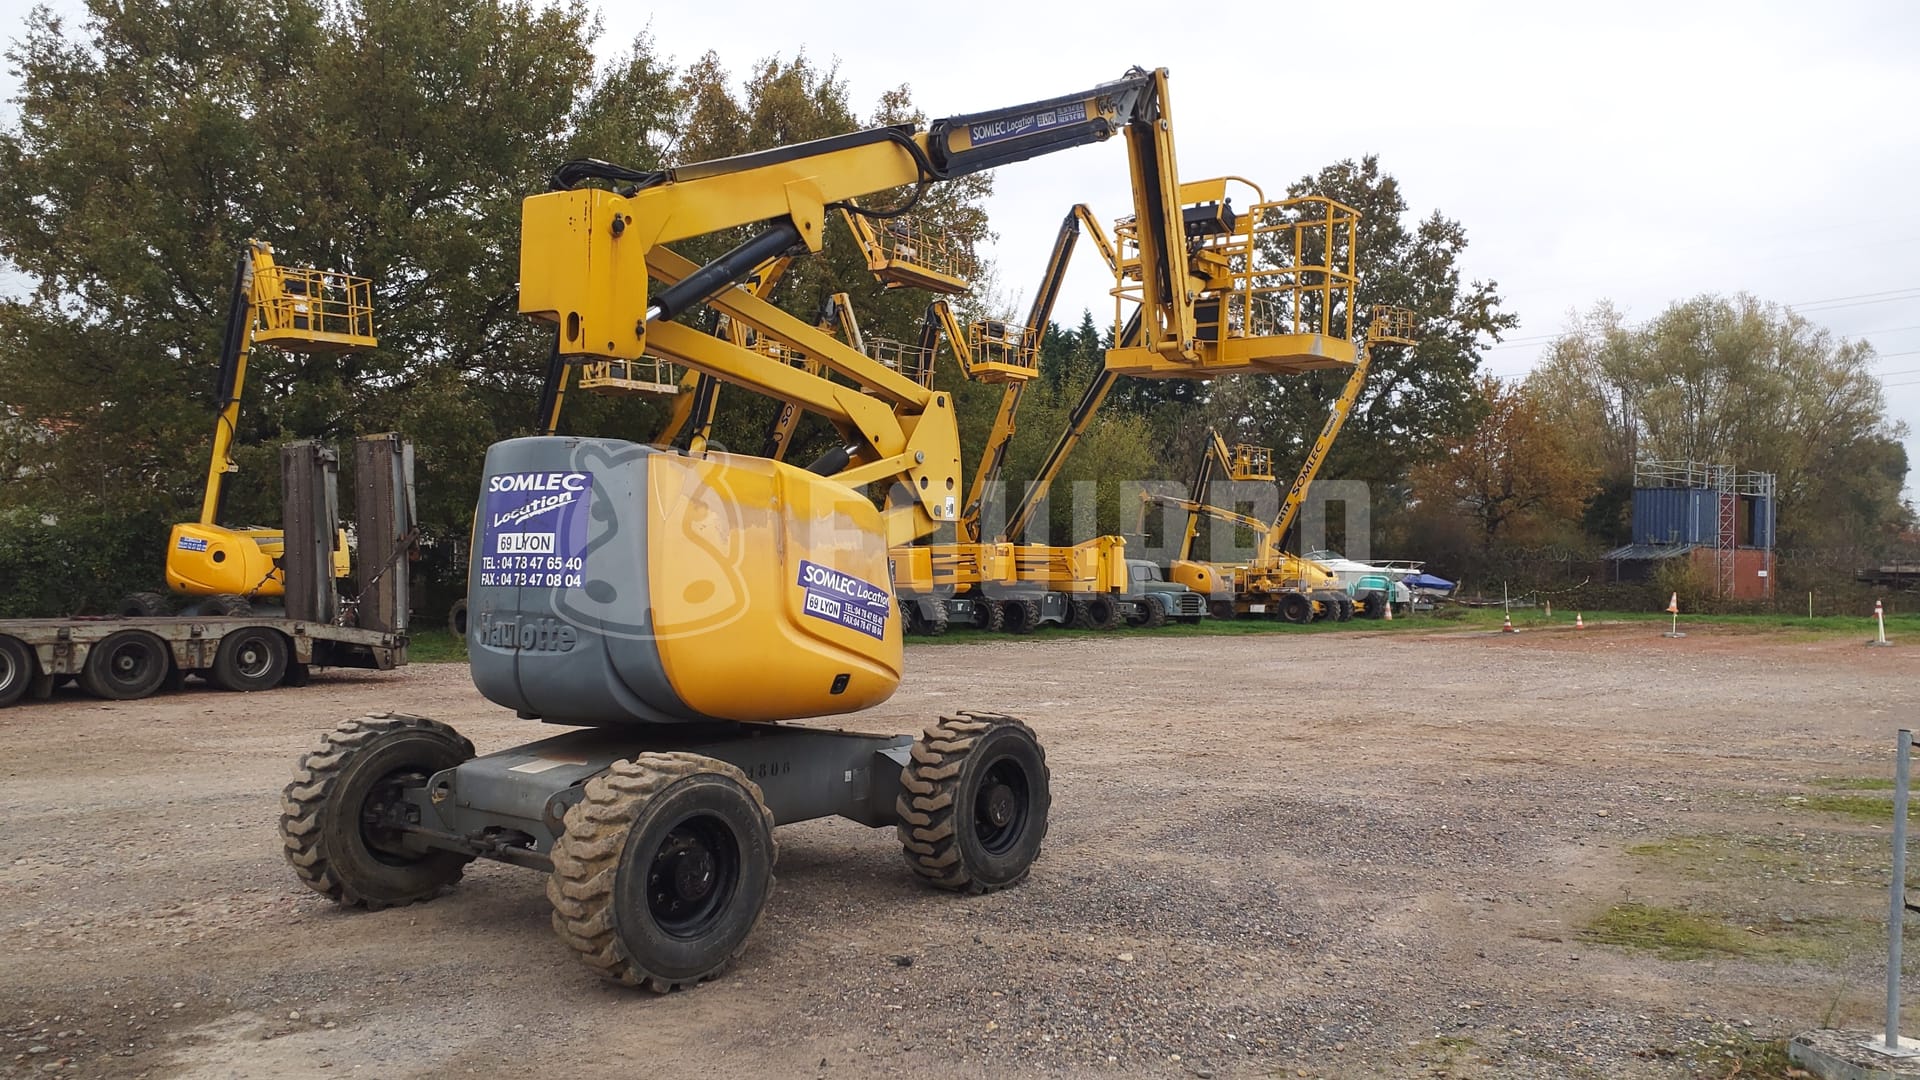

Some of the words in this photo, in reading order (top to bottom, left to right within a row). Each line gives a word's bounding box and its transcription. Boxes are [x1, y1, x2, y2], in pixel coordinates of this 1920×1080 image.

[973, 121, 1006, 140] SOMLEC
[1006, 114, 1035, 132] Location
[1292, 441, 1324, 498] SOMLEC
[489, 473, 586, 492] SOMLEC
[494, 491, 572, 528] Location
[500, 536, 512, 550] 69
[515, 536, 551, 550] LYON
[501, 556, 513, 569] 04
[515, 556, 528, 569] 78
[530, 557, 544, 570] 47
[547, 557, 562, 570] 65
[565, 557, 582, 570] 40
[501, 573, 512, 585] 04
[514, 573, 527, 586] 78
[529, 573, 543, 586] 47
[546, 574, 562, 586] 08
[565, 574, 581, 587] 04
[803, 565, 856, 596] SOMLEC
[809, 596, 819, 610] 69
[820, 599, 839, 617] LYON
[481, 612, 577, 652] Haulotte
